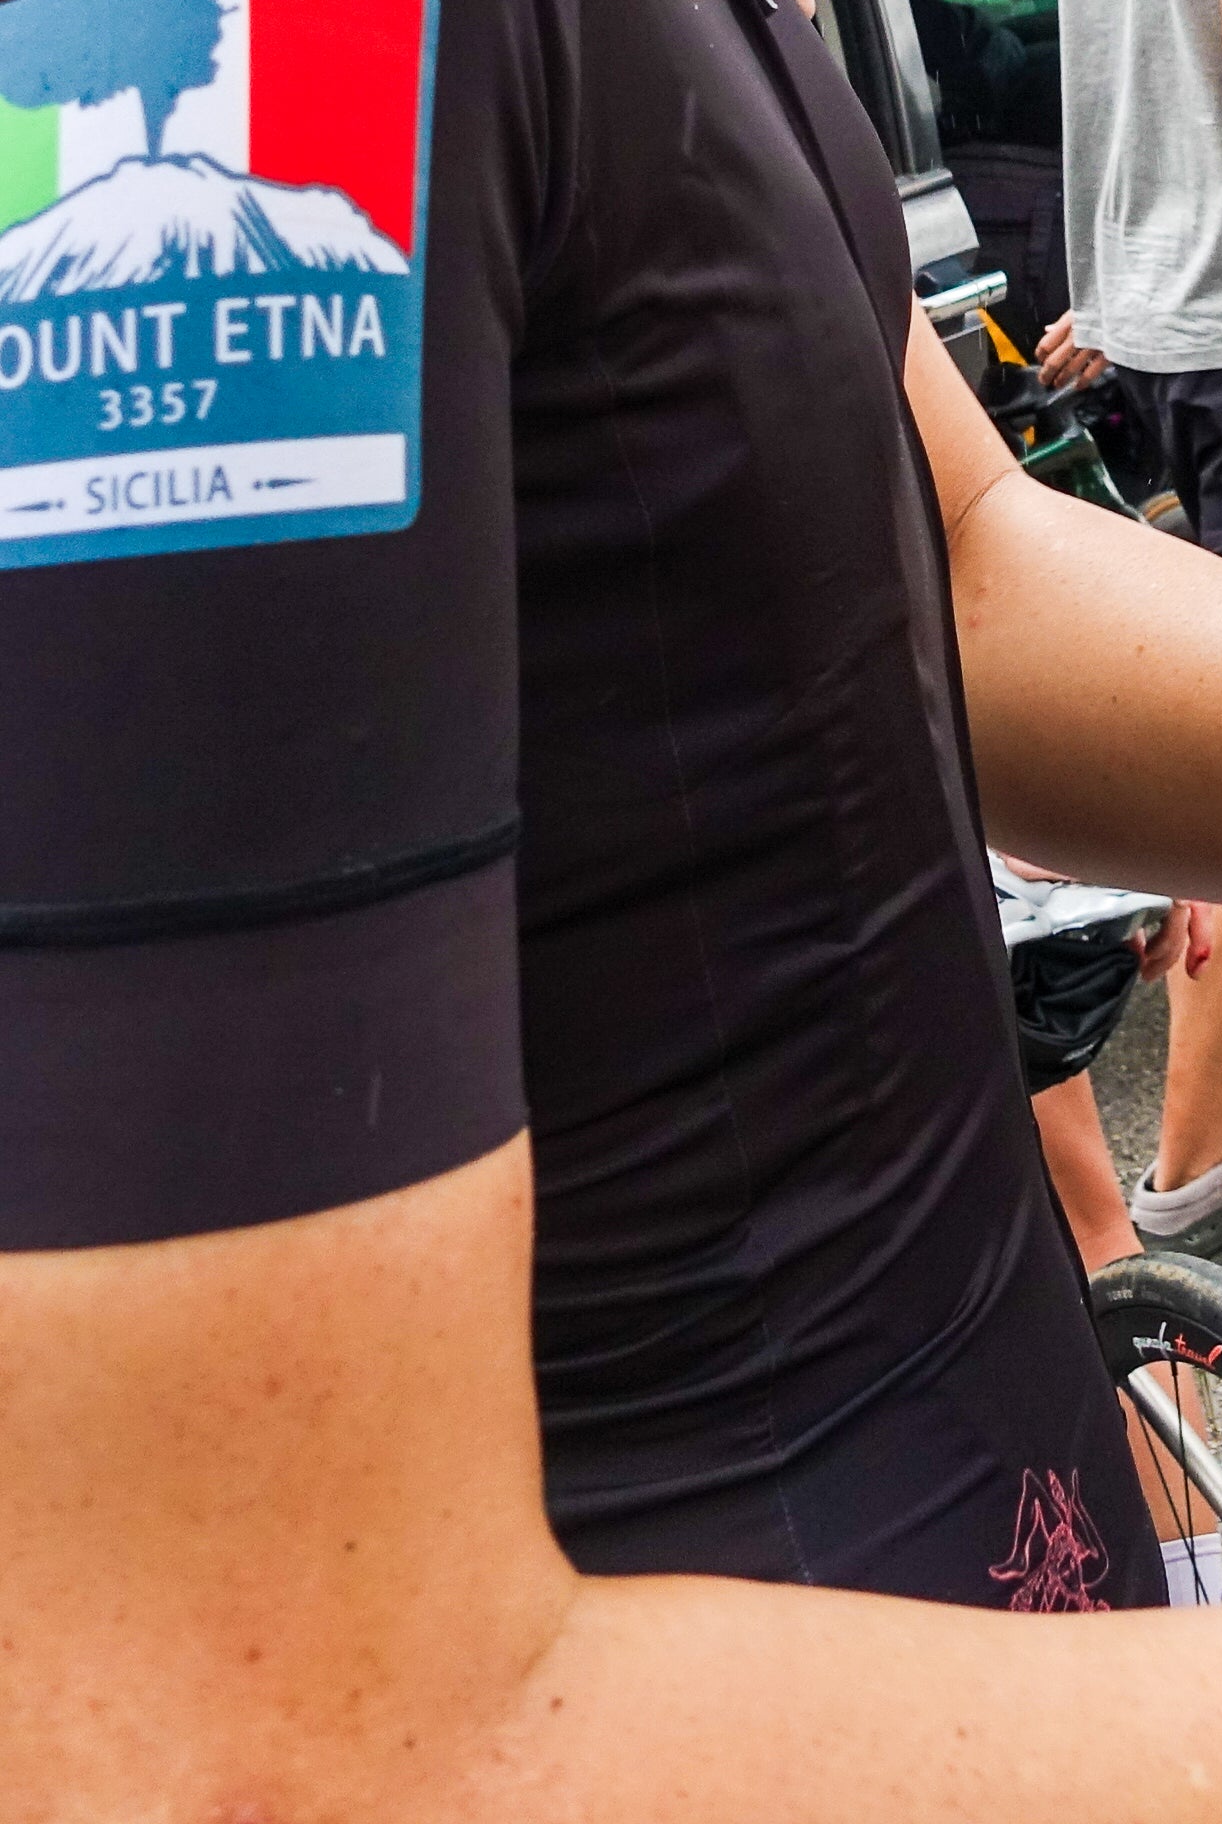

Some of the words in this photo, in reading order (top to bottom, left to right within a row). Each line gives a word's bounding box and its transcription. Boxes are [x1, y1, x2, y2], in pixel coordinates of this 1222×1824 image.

[0, 302, 187, 391] OUNT
[214, 293, 386, 365] ETNA
[98, 378, 219, 432] 3357
[86, 464, 234, 515] SICILIA
